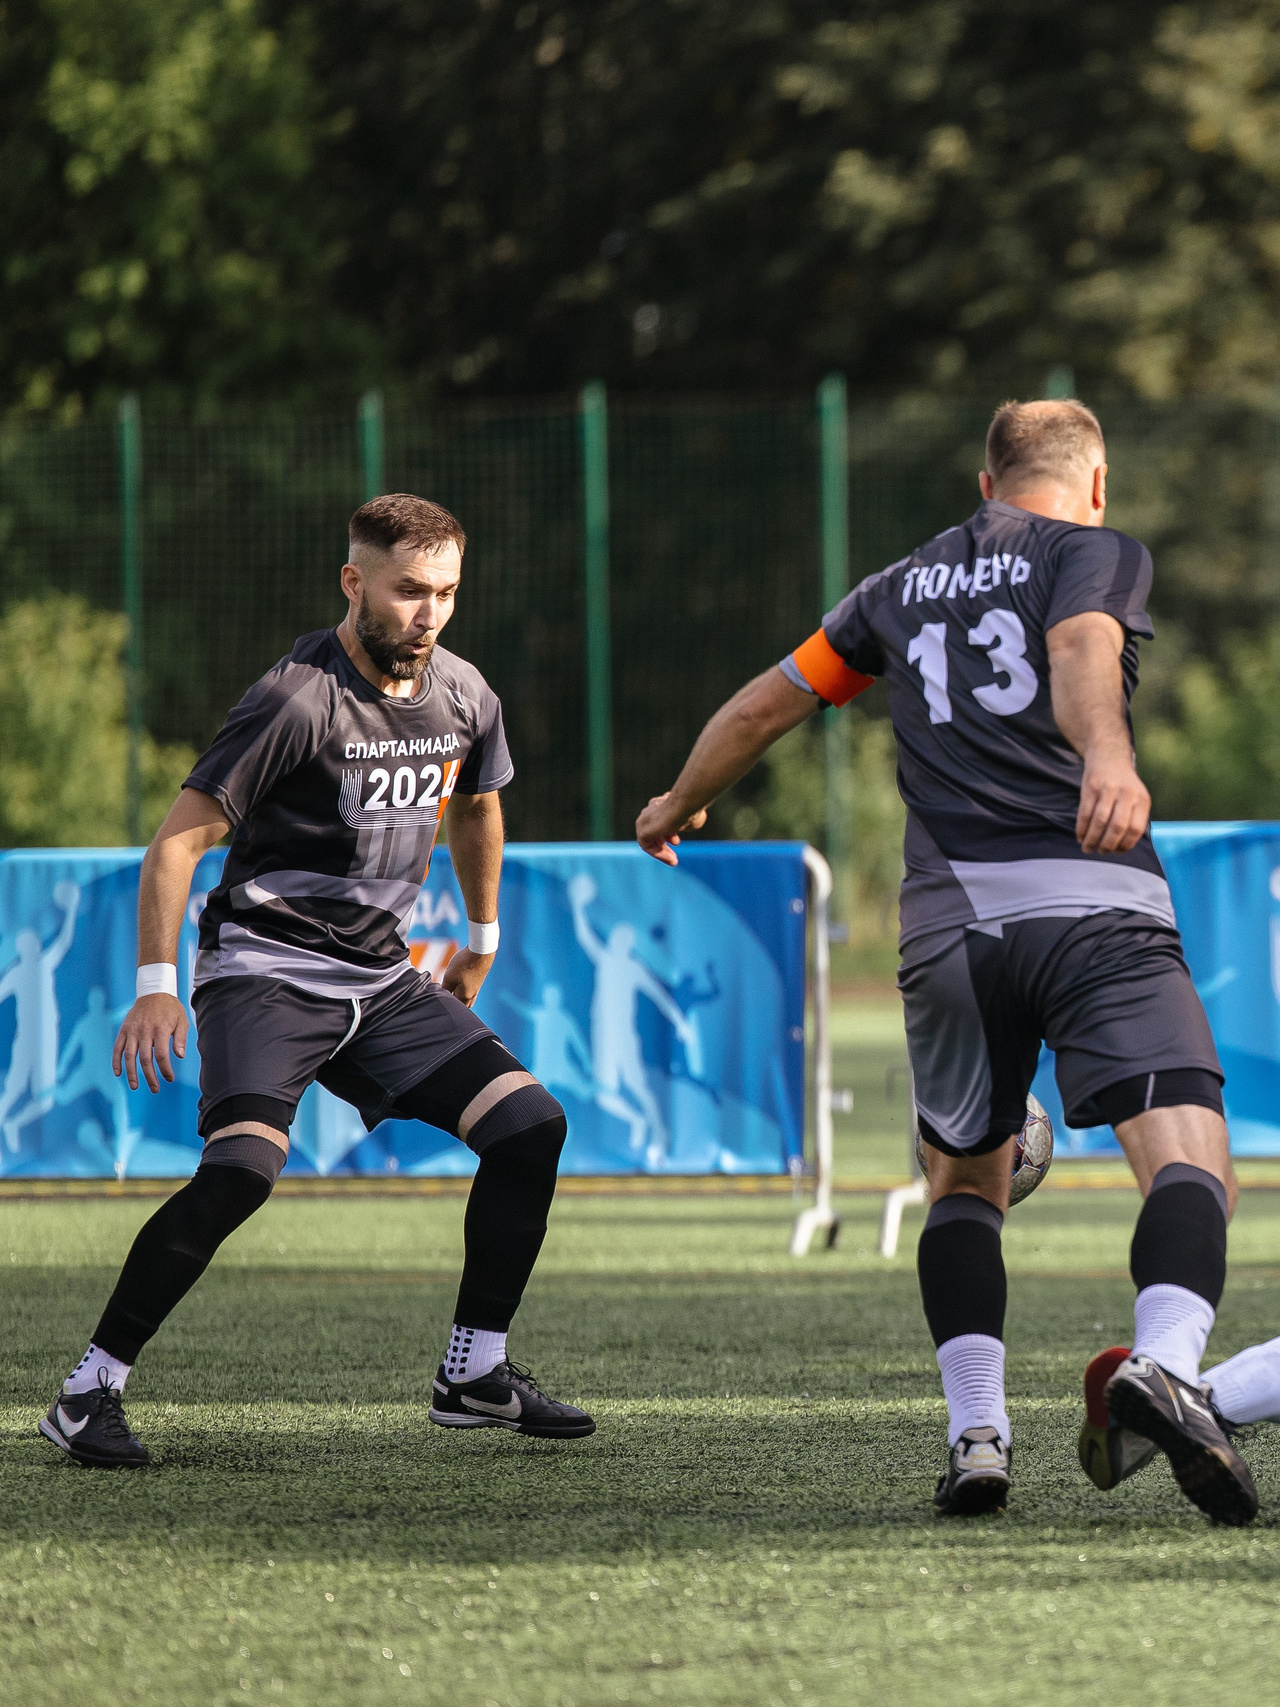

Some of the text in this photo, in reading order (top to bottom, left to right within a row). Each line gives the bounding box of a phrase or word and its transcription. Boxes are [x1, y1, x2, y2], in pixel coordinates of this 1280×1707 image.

[907, 608, 1039, 725] 13
[345, 732, 461, 759] СПАРТАКИАДА
[364, 758, 460, 811] 2024
